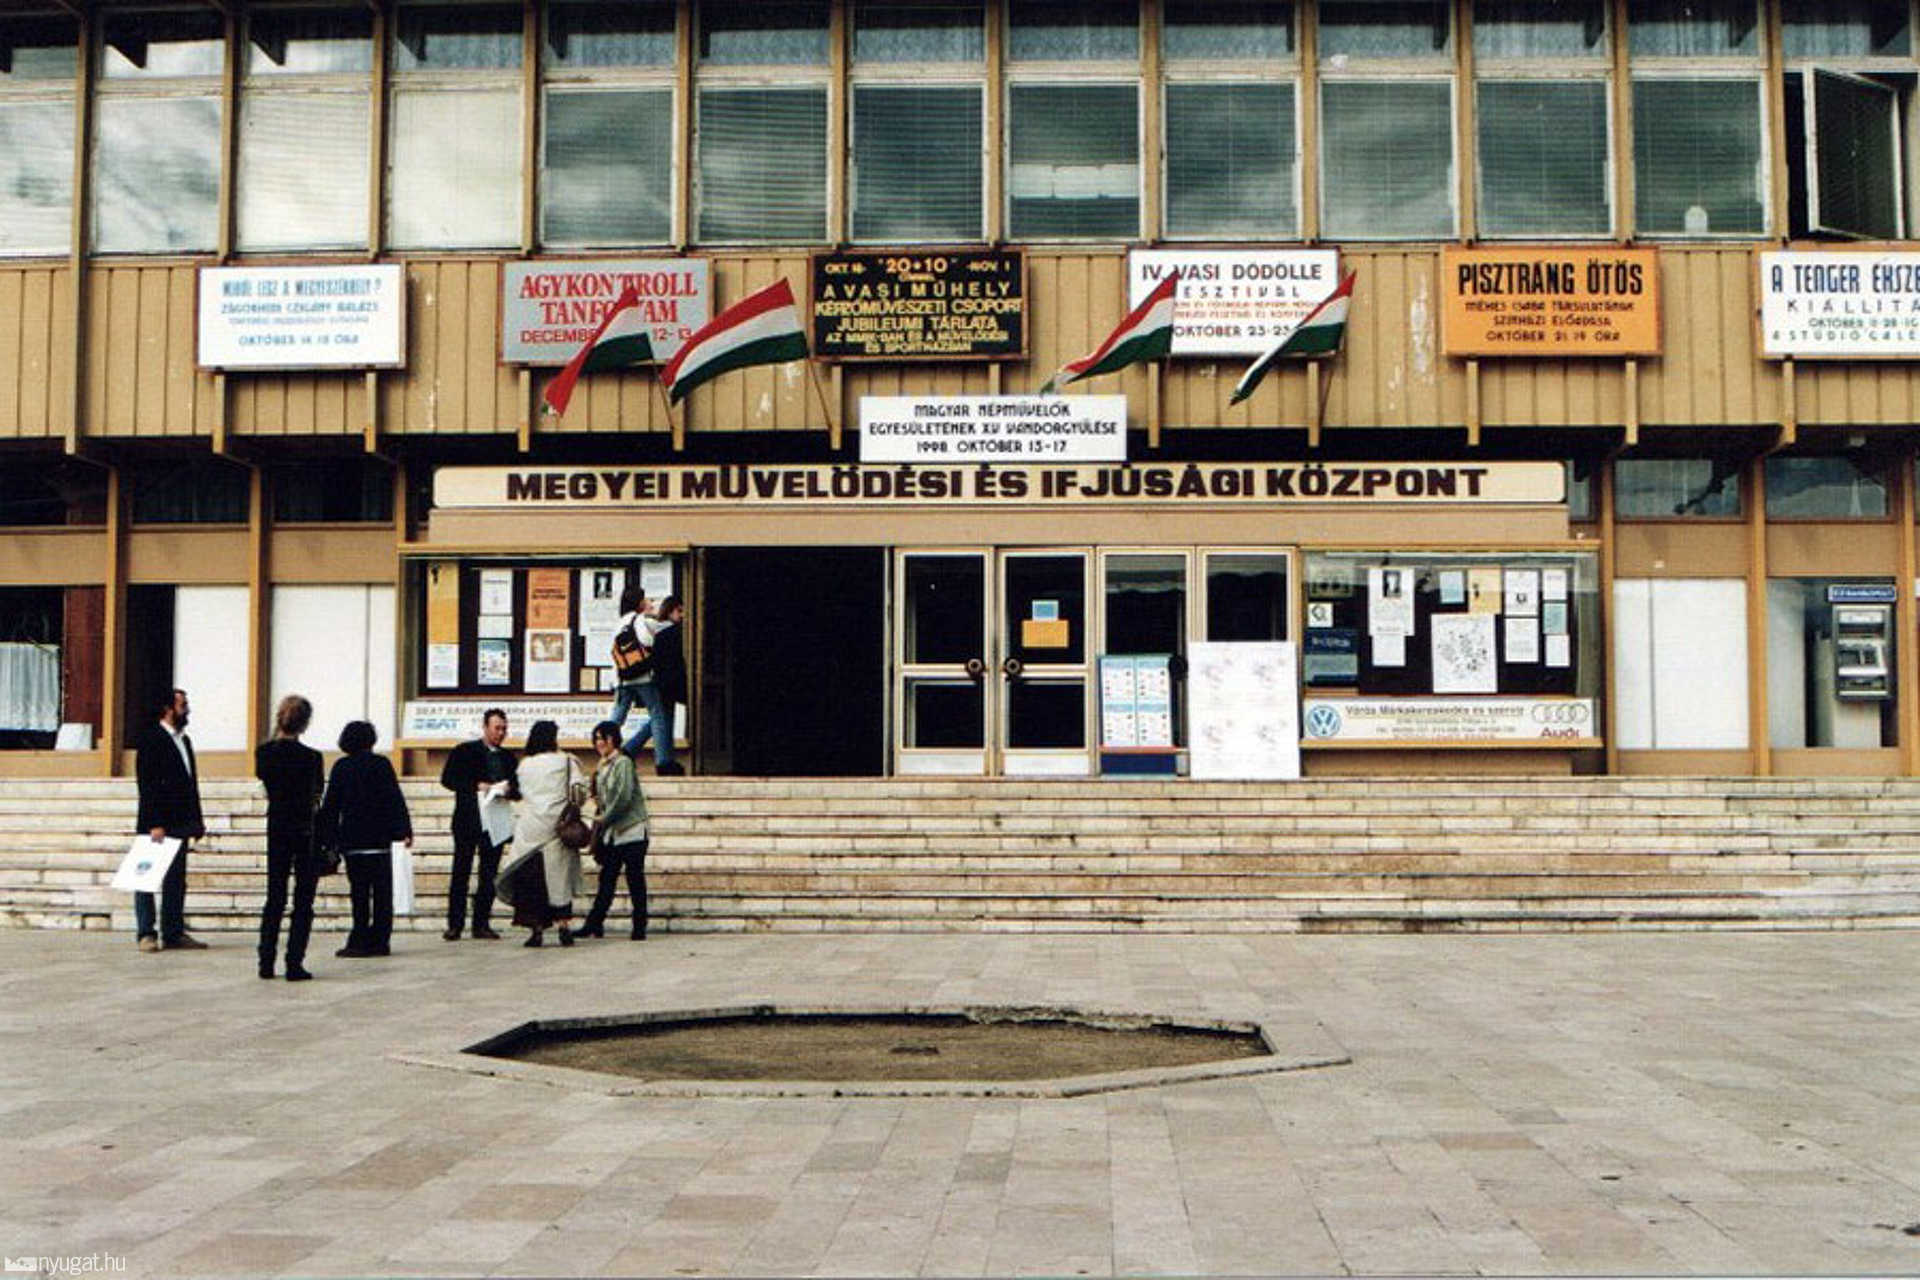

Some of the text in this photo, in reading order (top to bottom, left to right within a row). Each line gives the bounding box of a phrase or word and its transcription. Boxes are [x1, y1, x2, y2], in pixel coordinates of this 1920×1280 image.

[1173, 264, 1219, 280] VASI
[1458, 260, 1575, 296] PISZTRÁNG
[1772, 264, 1783, 293] A
[1793, 264, 1860, 293] TENGER
[520, 271, 698, 298] AGYKONTROLL
[824, 284, 836, 299] A
[844, 283, 899, 298] VASI
[952, 298, 1022, 314] CSOPORT
[826, 332, 841, 342] AZ
[914, 403, 970, 417] MAGYAR
[917, 440, 948, 453] 1998
[957, 438, 1023, 453] OKTÓBER
[507, 472, 669, 500] MEGYEI
[974, 463, 1028, 498] ÉS
[1042, 462, 1255, 498] IFJÚSÁGI
[1266, 463, 1487, 497] KÖZPONT
[1541, 726, 1580, 739] Audi
